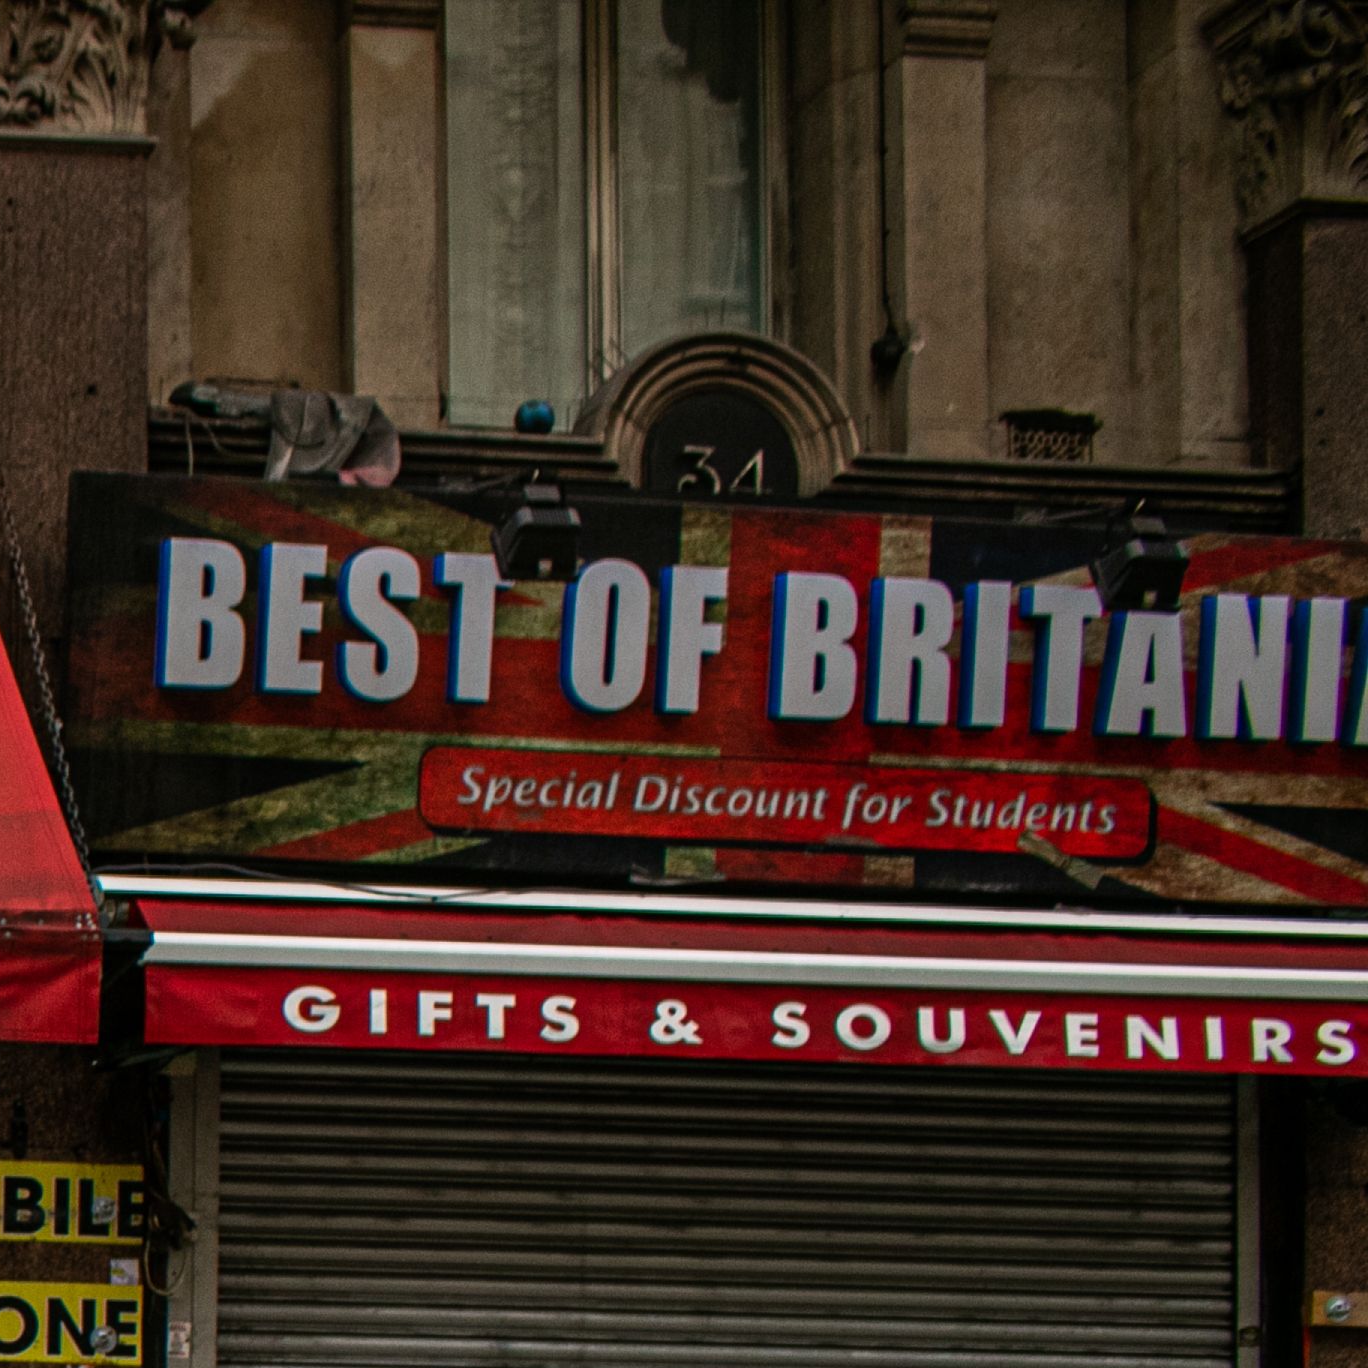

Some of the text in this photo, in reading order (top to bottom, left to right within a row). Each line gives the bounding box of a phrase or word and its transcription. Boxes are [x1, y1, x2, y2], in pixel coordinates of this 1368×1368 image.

[677, 444, 769, 495] 34
[154, 537, 1368, 747] BEST OF BRITANI
[457, 762, 1119, 834] Special Discount for Students
[282, 983, 1361, 1067] GIFTS & SOUVENIRS
